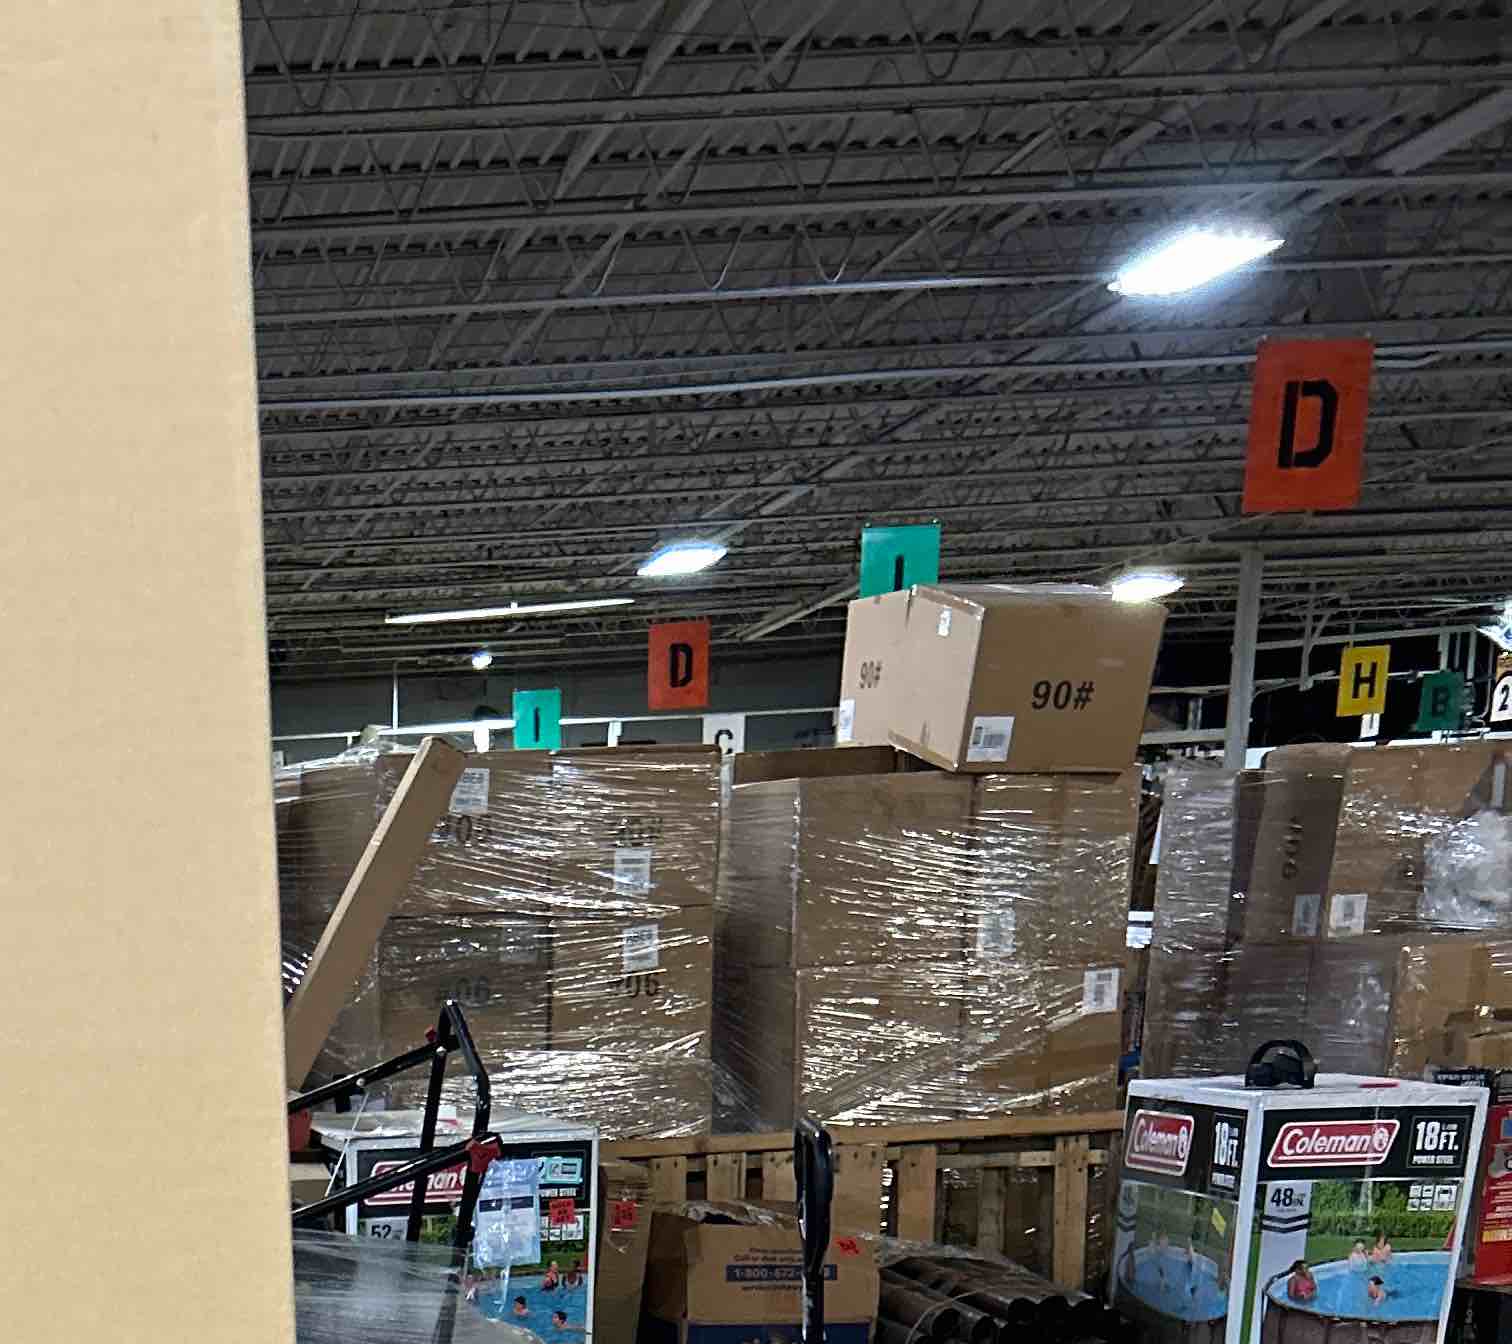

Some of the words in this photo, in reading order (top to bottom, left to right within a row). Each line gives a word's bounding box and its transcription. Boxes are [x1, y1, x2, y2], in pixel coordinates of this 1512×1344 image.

[1277, 378, 1338, 469] D
[669, 643, 693, 688] D
[1352, 662, 1378, 699] H
[1031, 680, 1095, 710] 90#
[1134, 1118, 1178, 1157] Coleman
[1214, 1122, 1229, 1165] 18
[1283, 1127, 1370, 1155] Coleman
[1416, 1121, 1439, 1150] 18
[1439, 1131, 1459, 1150] FT.
[1271, 1187, 1294, 1207] 48
[371, 1224, 392, 1239] 52
